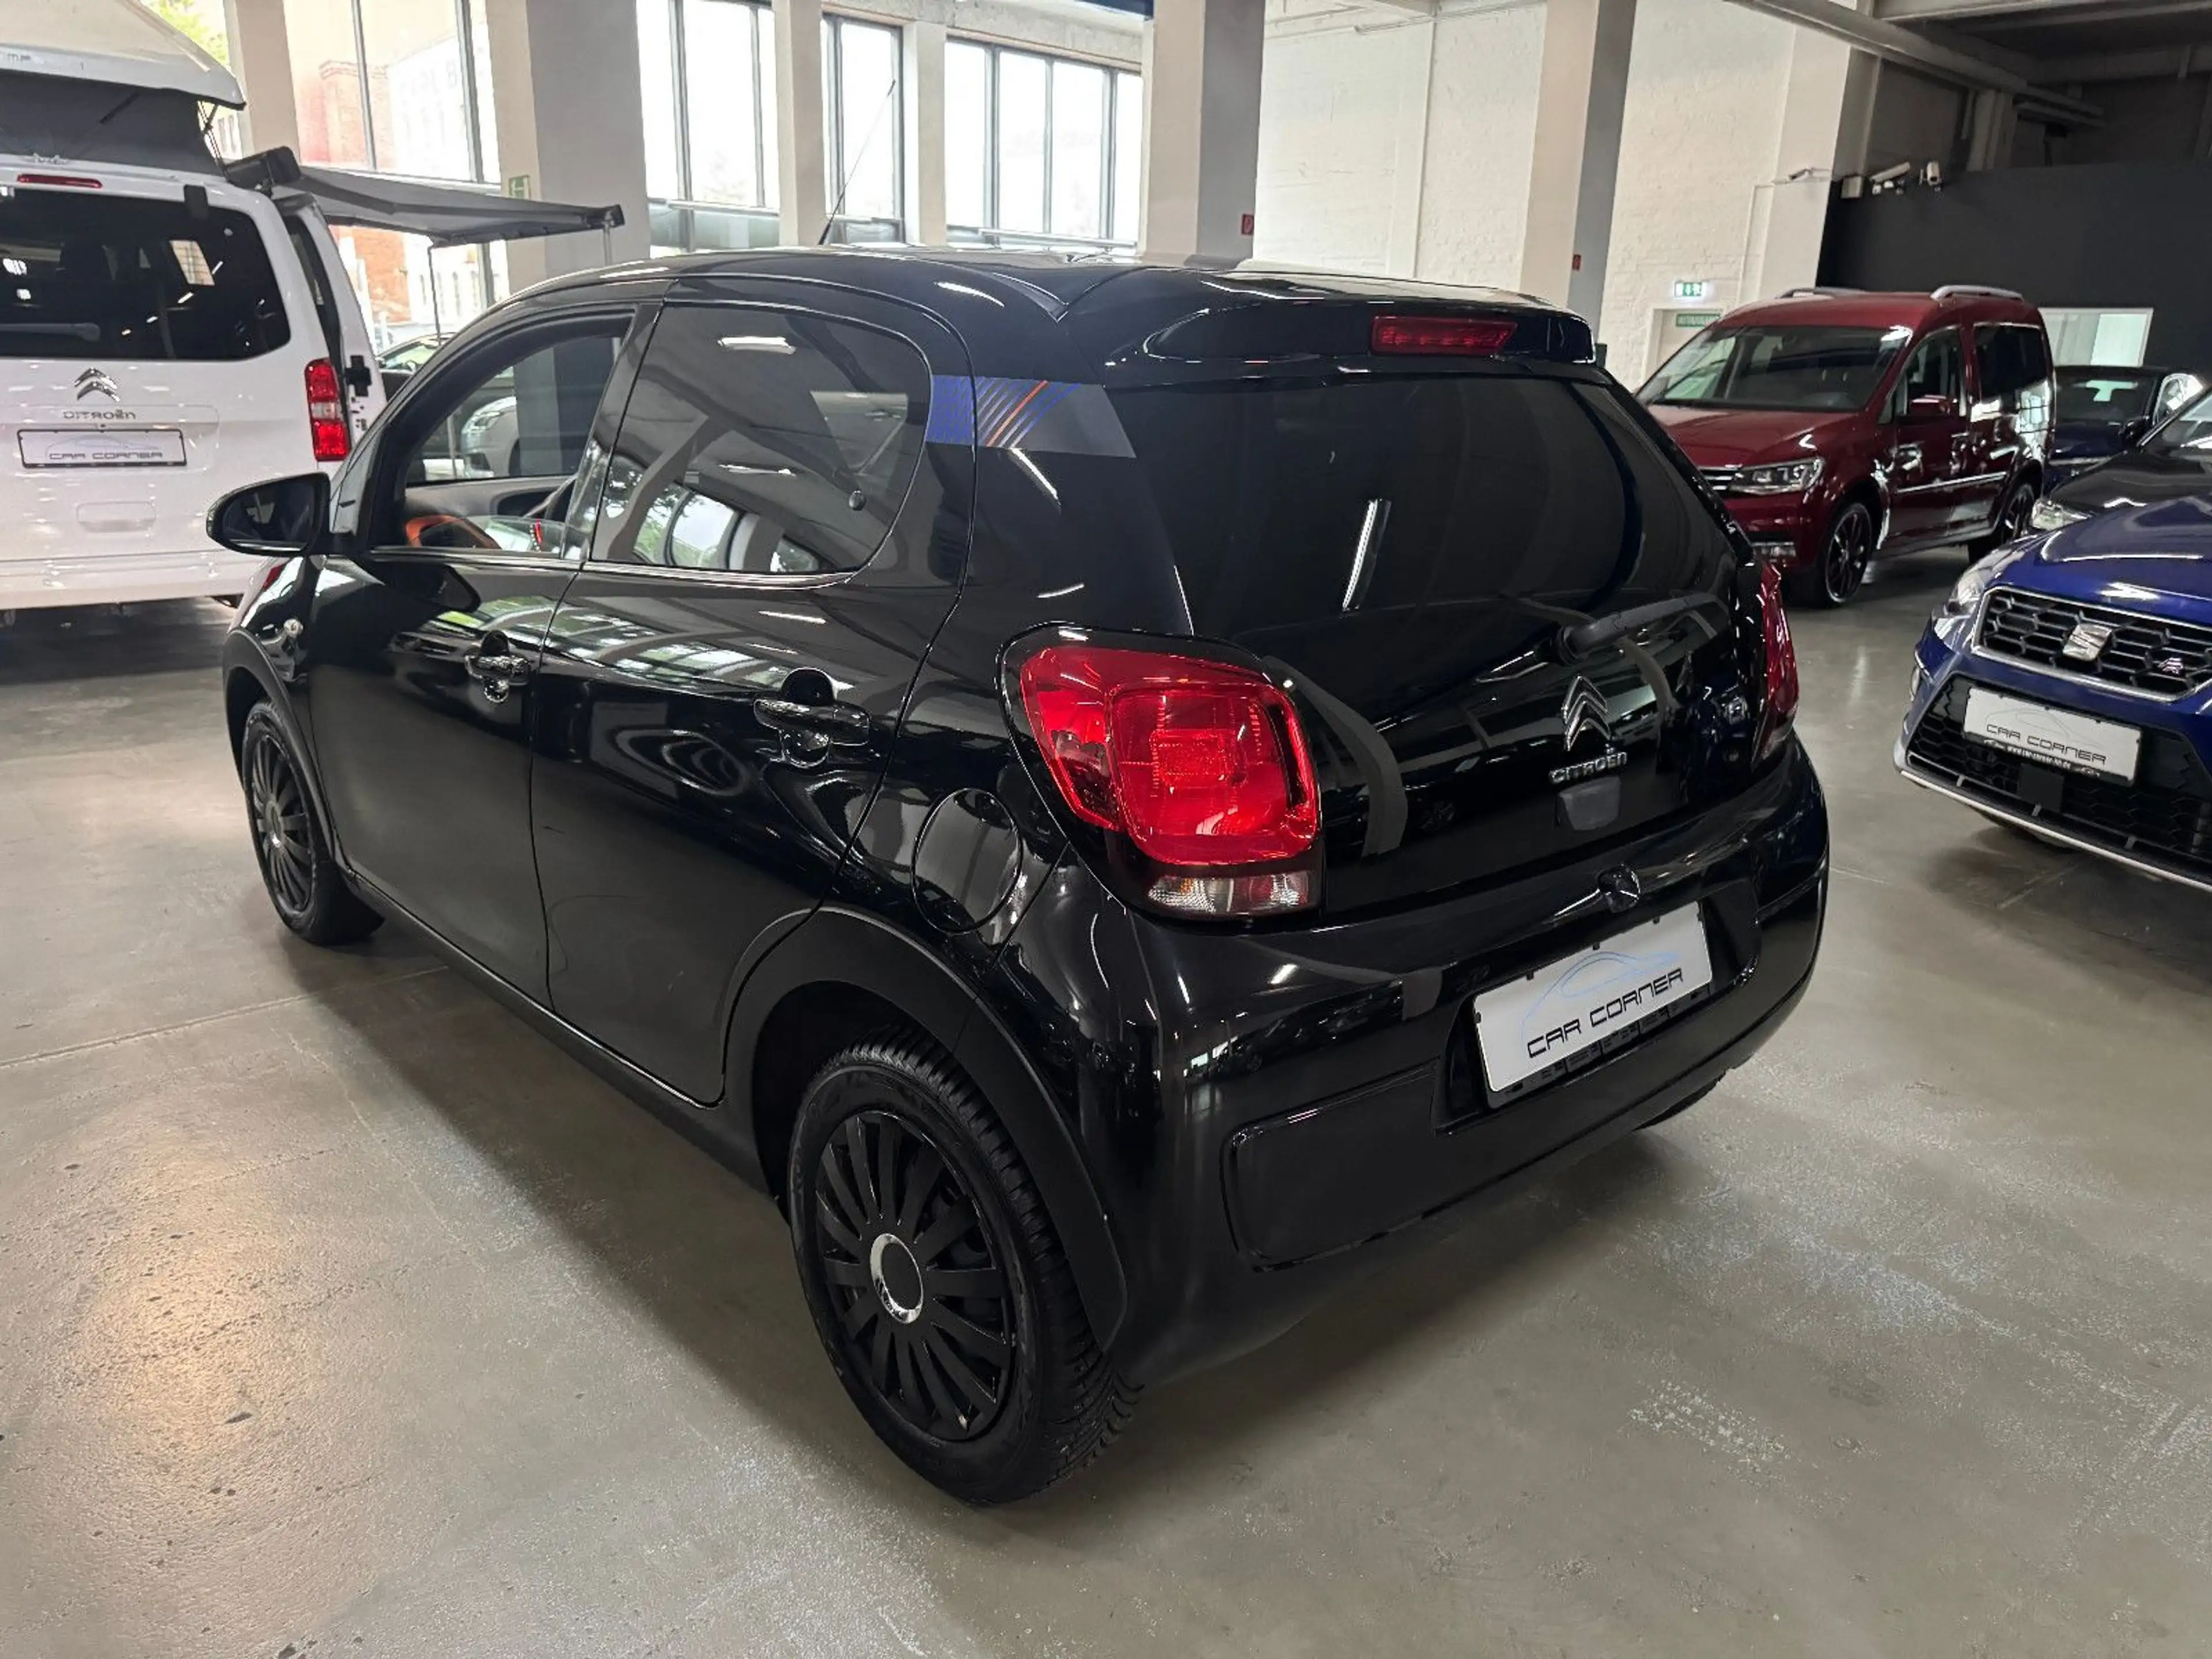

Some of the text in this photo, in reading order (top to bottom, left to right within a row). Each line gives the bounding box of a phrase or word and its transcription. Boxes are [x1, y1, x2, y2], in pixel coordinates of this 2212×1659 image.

[92, 452, 163, 460] CORNER
[1986, 724, 2021, 740] CAR
[2027, 734, 2107, 766] CORNER
[1527, 967, 1684, 1059] CAR CORNER
